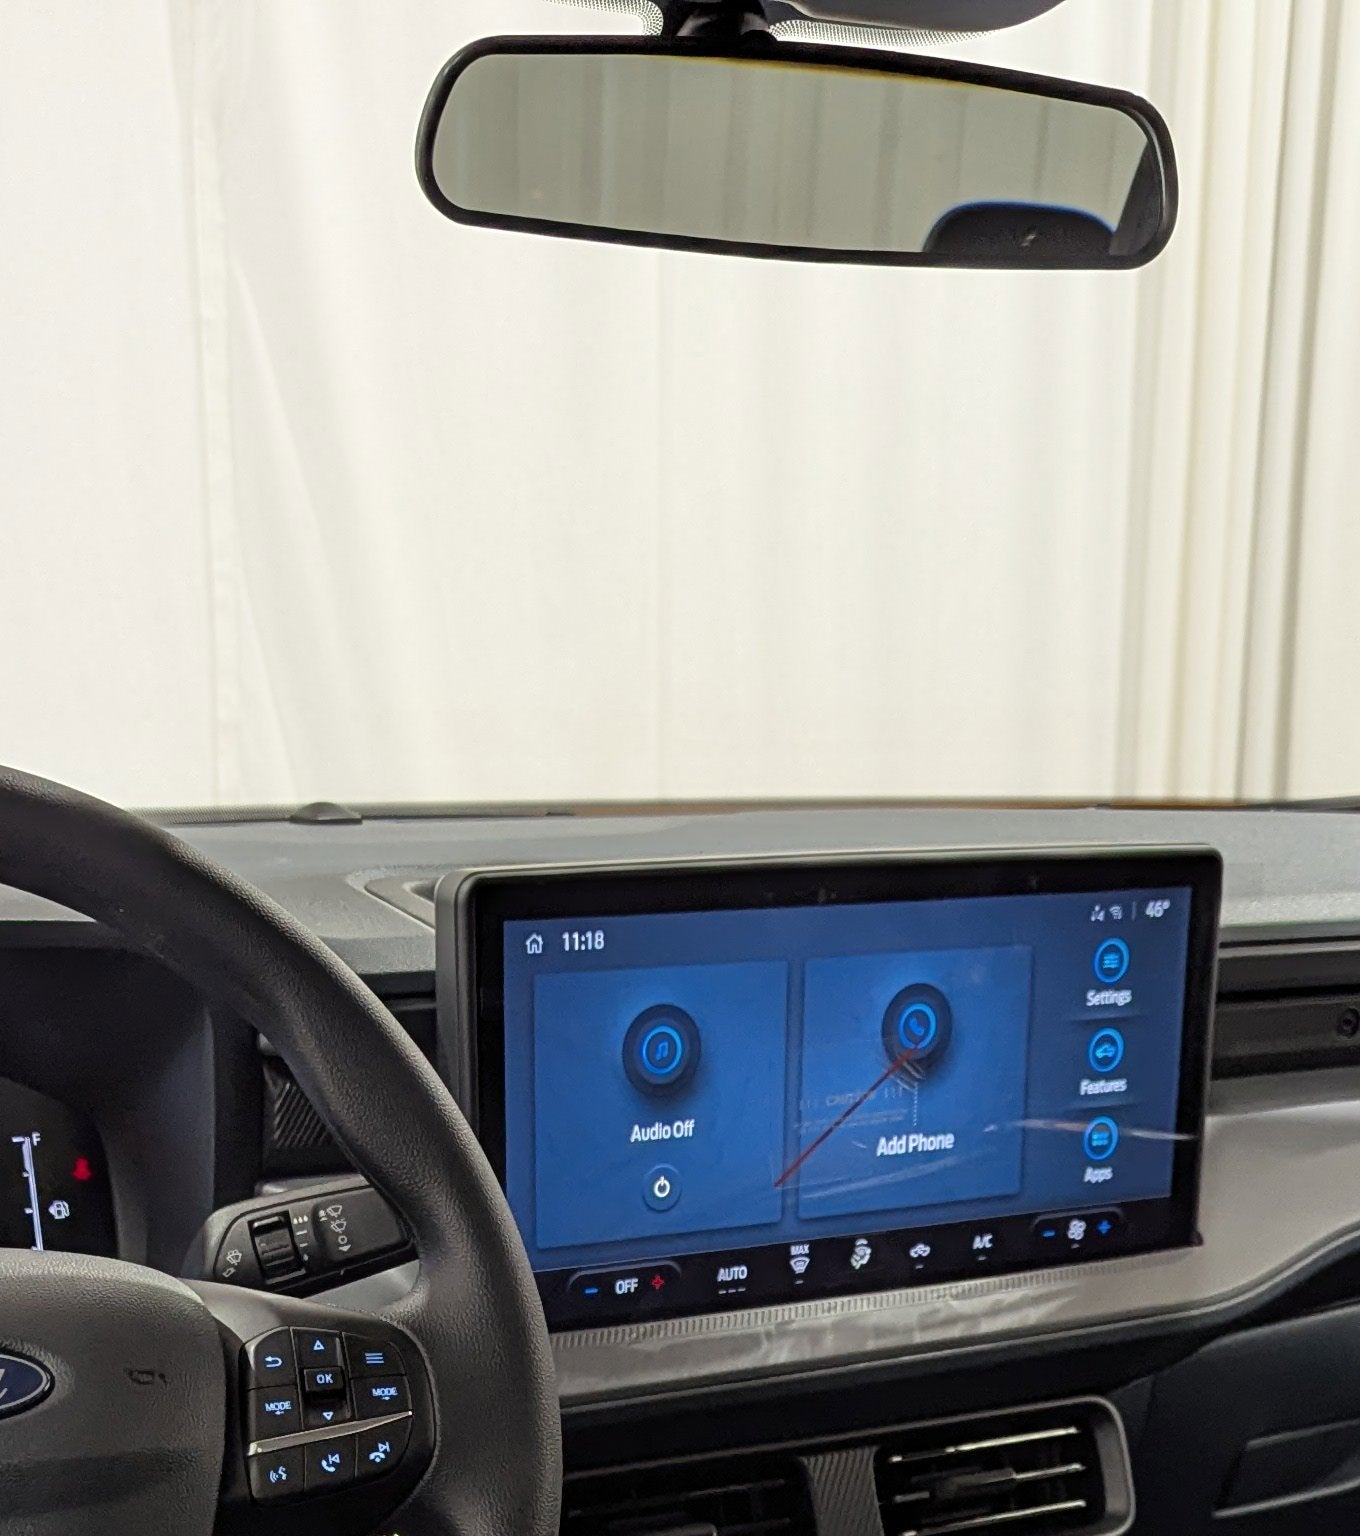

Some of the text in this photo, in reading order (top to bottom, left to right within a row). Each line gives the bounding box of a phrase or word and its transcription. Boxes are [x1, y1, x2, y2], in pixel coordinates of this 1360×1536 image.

[562, 930, 605, 951] 11:18
[1086, 988, 1133, 1006] Settings
[1079, 1078, 1128, 1095] Features
[630, 1119, 695, 1143] Audio Off
[876, 1132, 955, 1157] Add Phone
[1083, 1166, 1113, 1184] Apps
[790, 1243, 810, 1255] MAX
[972, 1233, 993, 1250] A/C
[717, 1265, 748, 1283] AUTO
[615, 1277, 639, 1295] OFF
[316, 1372, 334, 1384] OK
[371, 1386, 398, 1397] MODE
[264, 1401, 292, 1411] MODE
